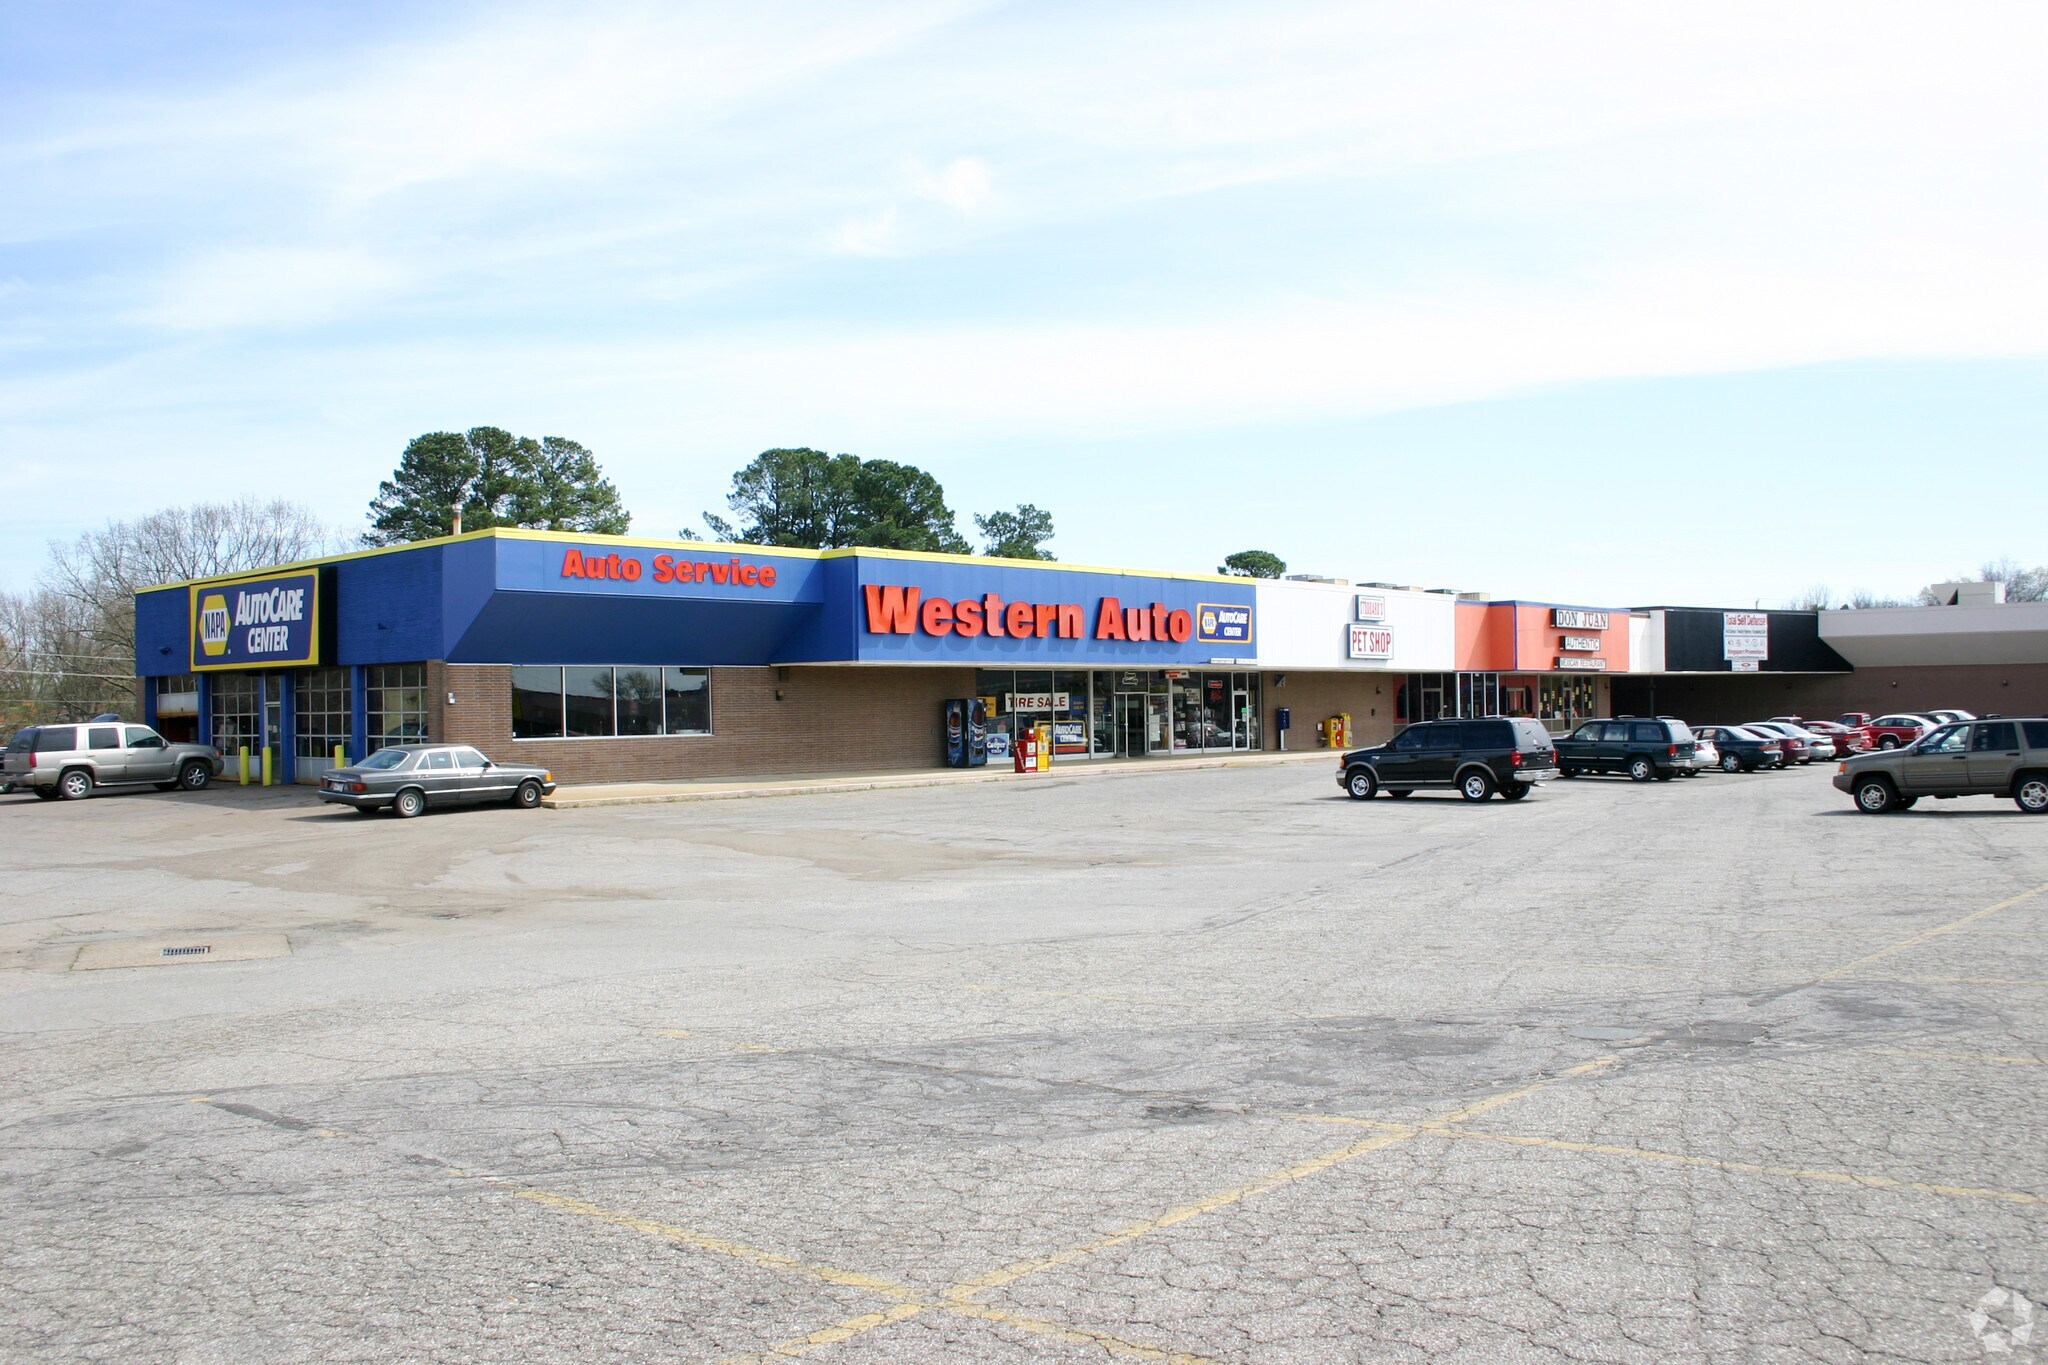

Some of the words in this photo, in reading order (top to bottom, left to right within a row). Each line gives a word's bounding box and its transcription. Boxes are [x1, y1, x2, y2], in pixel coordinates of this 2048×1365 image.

[562, 549, 642, 581] Auto
[653, 554, 776, 587] Service
[863, 584, 1084, 639] Western
[1096, 597, 1192, 643] Auto
[1558, 611, 1578, 626] DON
[1582, 613, 1607, 628] JUAN
[205, 611, 226, 639] NAPA
[1224, 627, 1242, 636] CENTER
[248, 626, 288, 654] CENTER
[1352, 631, 1368, 652] PET
[1369, 631, 1391, 653] SHOP
[1566, 638, 1599, 649] AUTHENTIC
[1560, 659, 1579, 667] MEXICAN
[1580, 659, 1605, 668] RESTAURANT
[1008, 697, 1035, 708] TIRE
[986, 741, 1006, 750] Cooper
